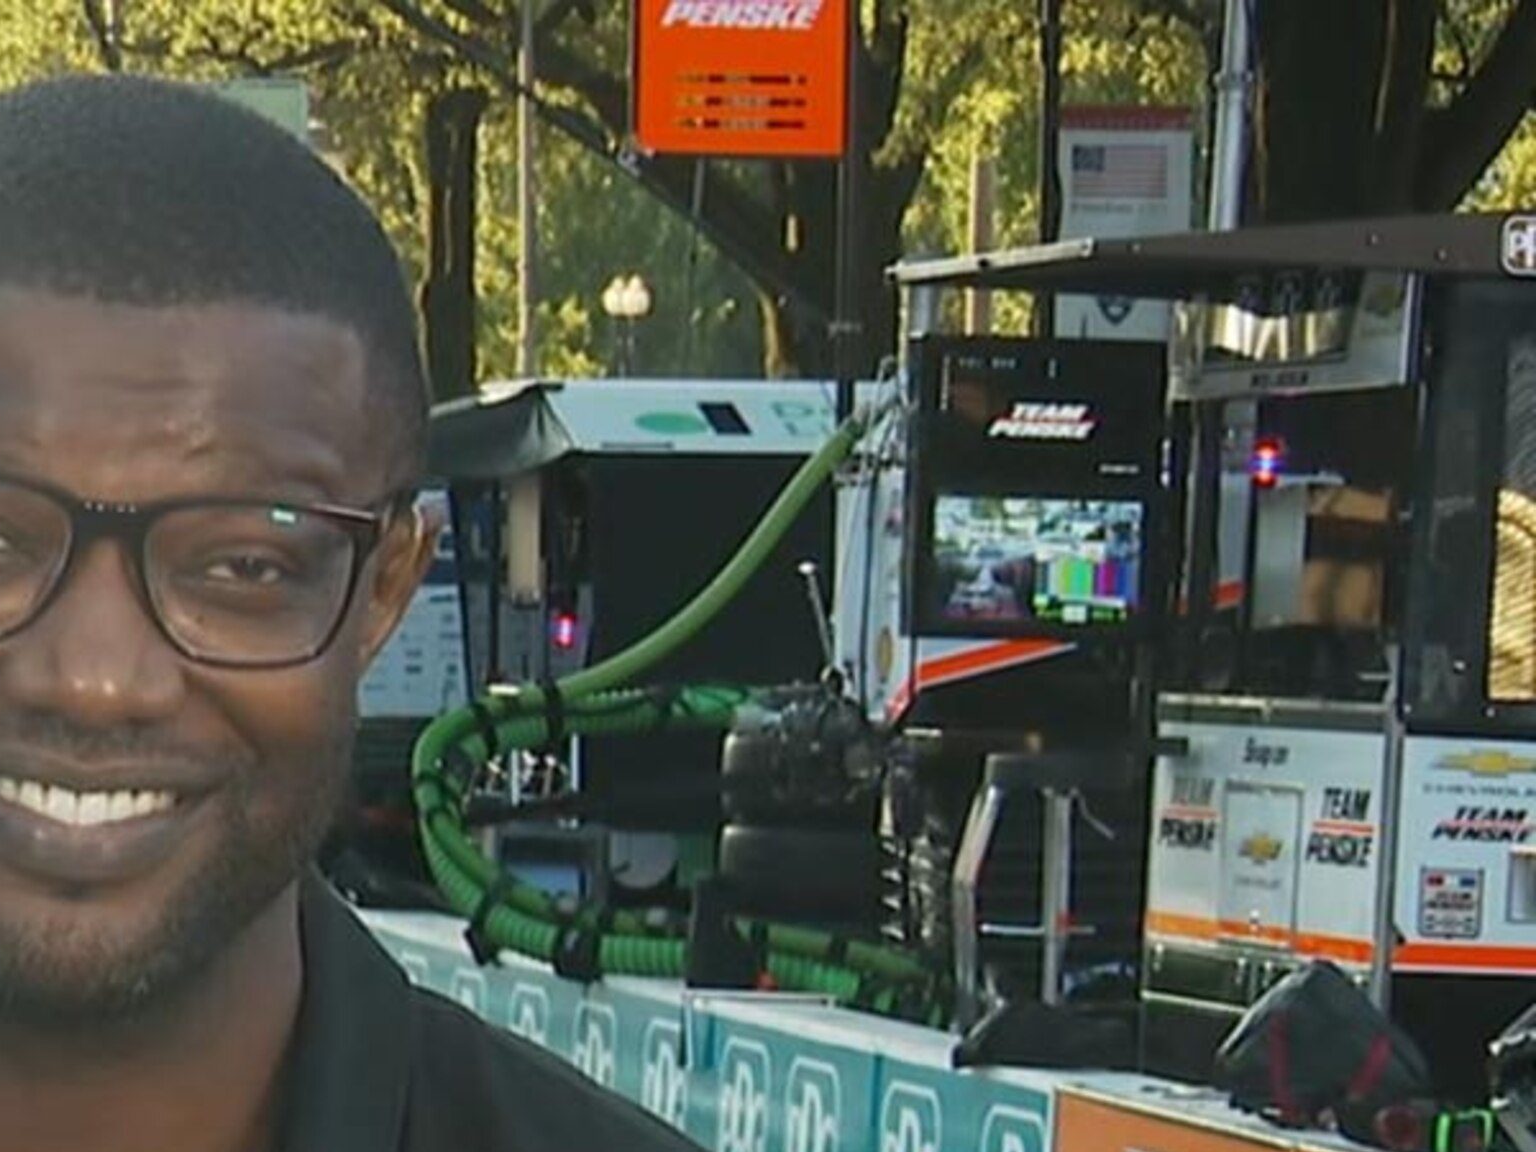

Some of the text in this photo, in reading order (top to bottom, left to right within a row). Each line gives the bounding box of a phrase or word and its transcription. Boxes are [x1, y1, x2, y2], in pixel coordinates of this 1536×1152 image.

[660, 0, 823, 31] PENSKE
[1013, 403, 1089, 421] TEAM
[989, 419, 1096, 439] PENSKE
[1322, 787, 1371, 821] TEAM
[1455, 806, 1528, 824] TEAM
[1158, 818, 1216, 851] PENSKE
[1431, 825, 1534, 844] PENSKE
[1306, 833, 1373, 868] PENSKE
